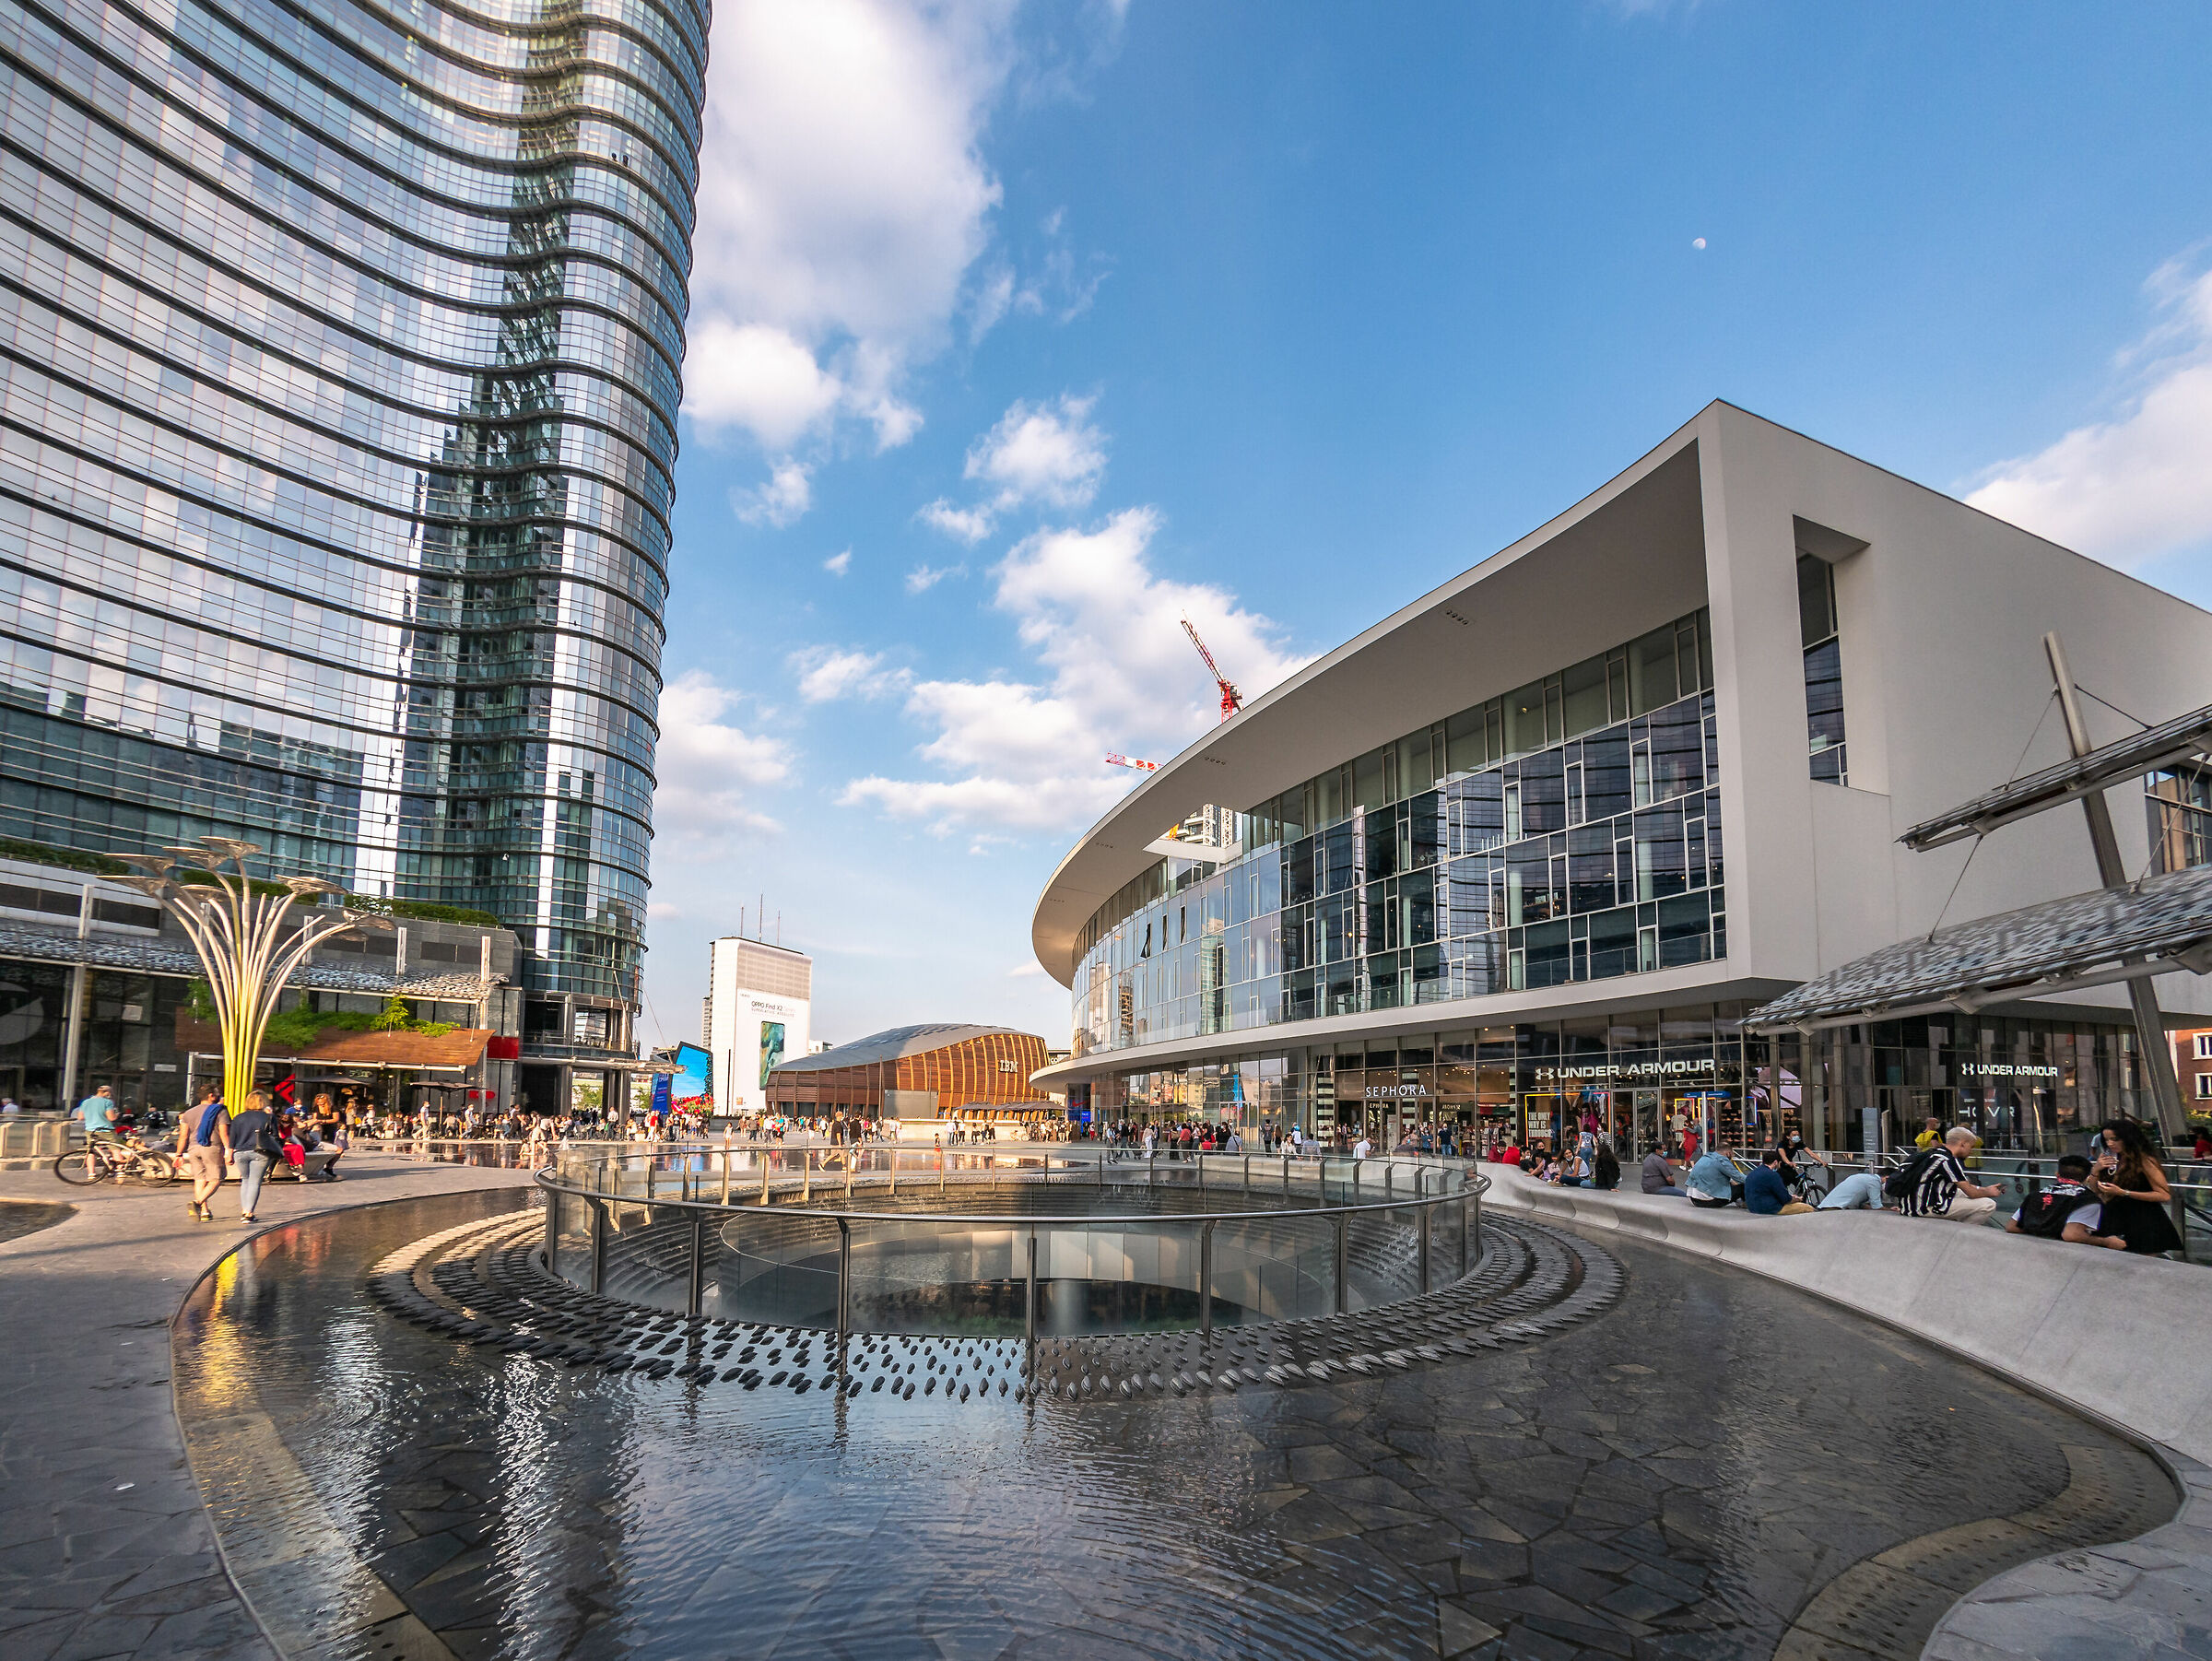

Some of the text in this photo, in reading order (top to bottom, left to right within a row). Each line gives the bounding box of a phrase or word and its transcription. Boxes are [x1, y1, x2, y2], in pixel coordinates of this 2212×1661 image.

[999, 1060, 1018, 1073] IBM
[1558, 1059, 1714, 1078] UNDER ARMOUR
[1977, 1064, 2058, 1077] UNDER ARMOUR
[1366, 1084, 1428, 1098] SEPHORA
[1528, 1112, 1537, 1121] THE
[1528, 1120, 1547, 1129] WAY IS
